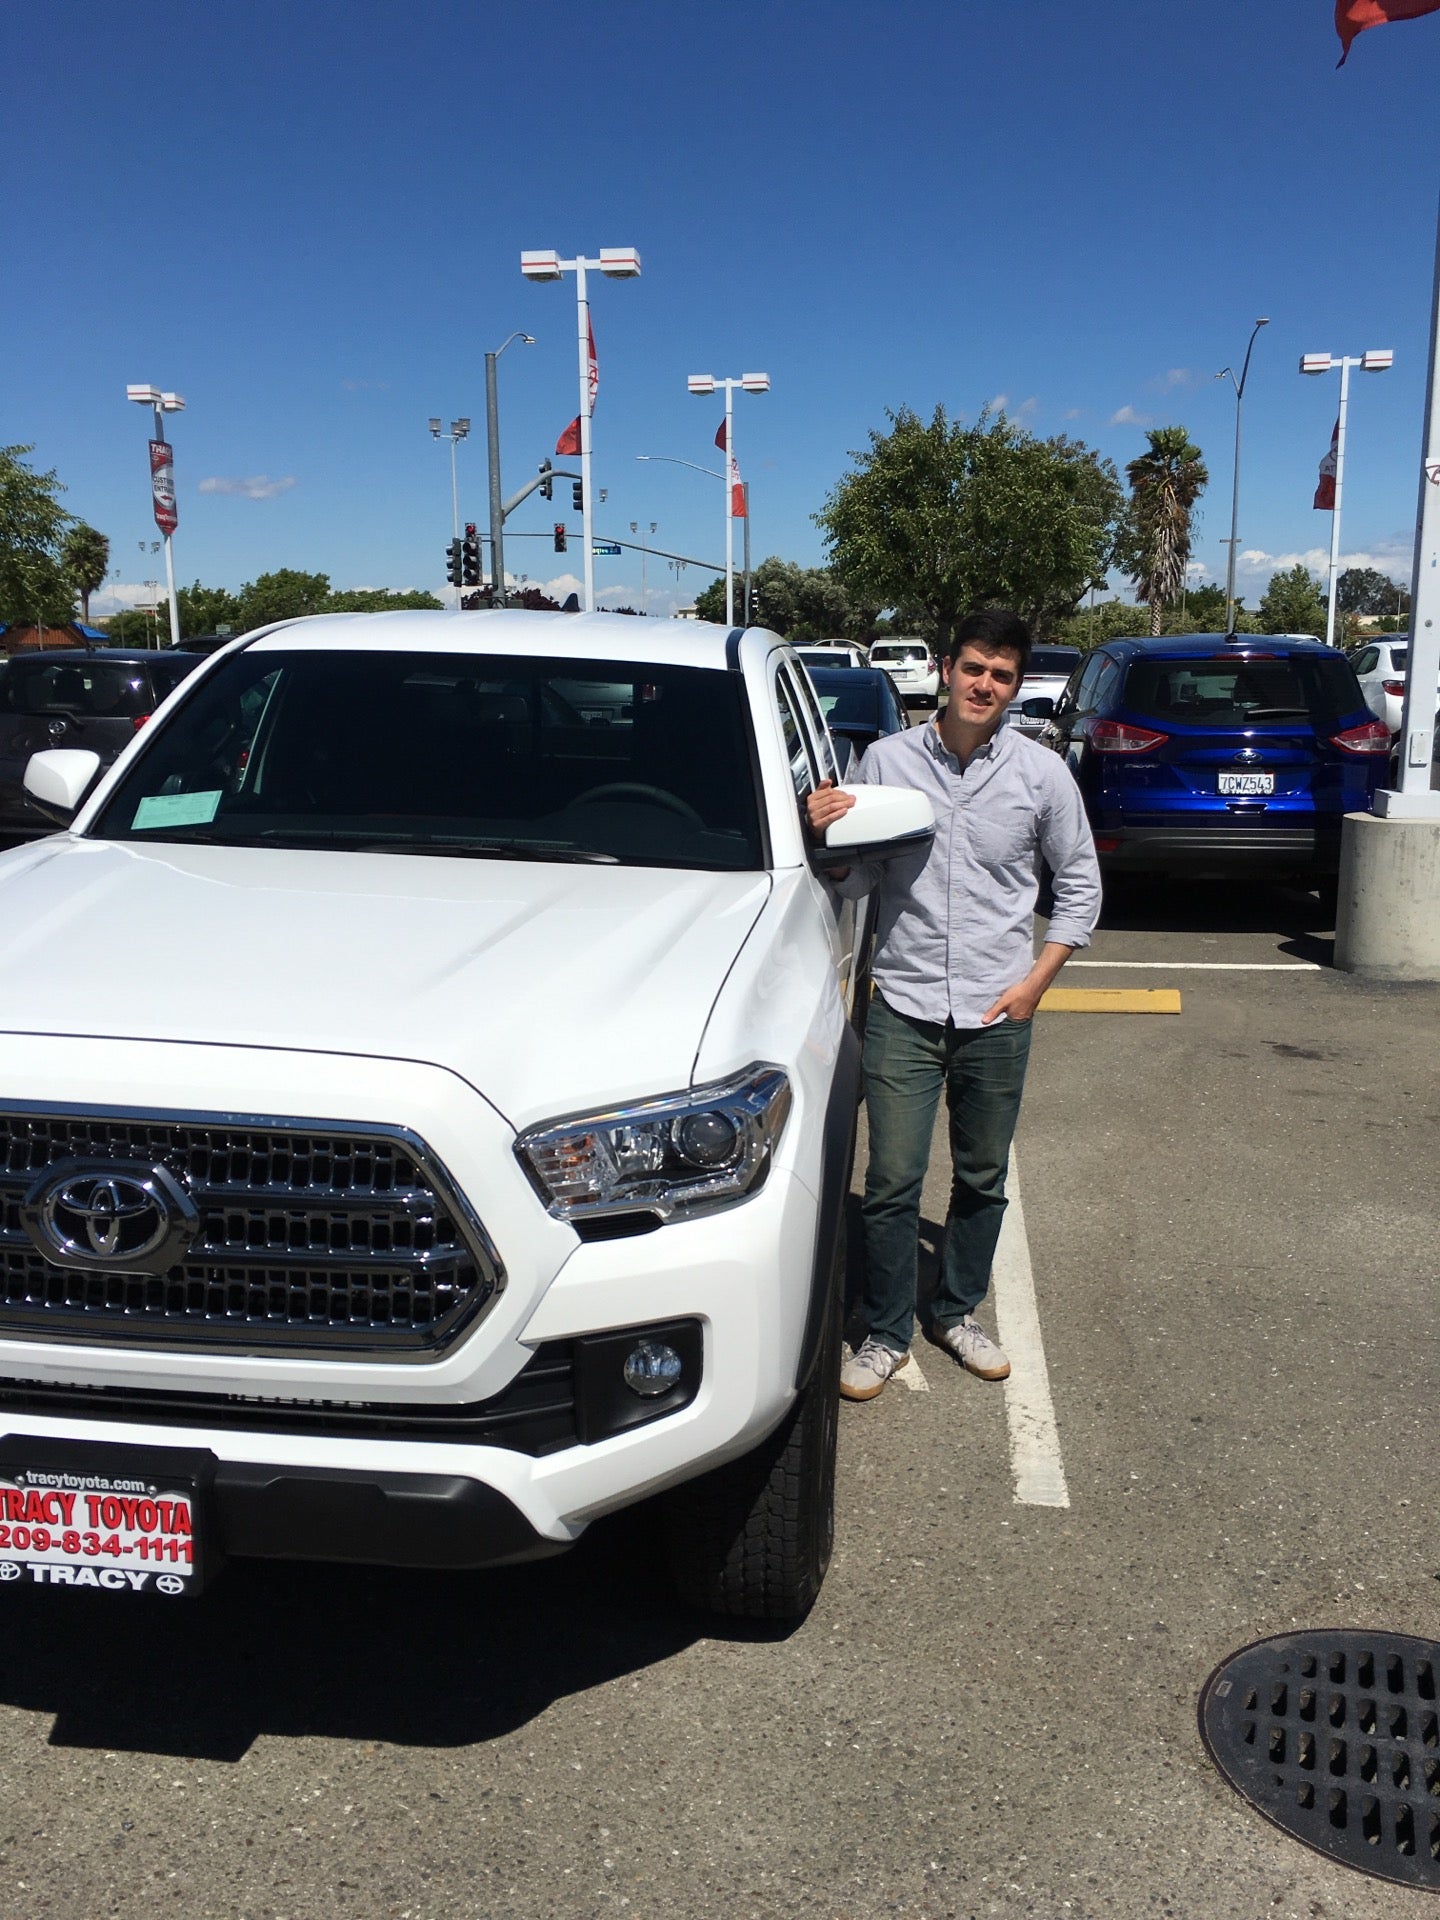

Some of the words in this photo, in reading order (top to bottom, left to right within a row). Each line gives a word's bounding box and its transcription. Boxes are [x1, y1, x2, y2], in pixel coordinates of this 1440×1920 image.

[1220, 776, 1272, 790] 7CWZ543
[26, 1471, 145, 1492] tracytoyota.com
[84, 1495, 191, 1536] TOYOTA
[0, 1525, 193, 1563] 209-834-1111
[27, 1564, 149, 1590] TRACY
